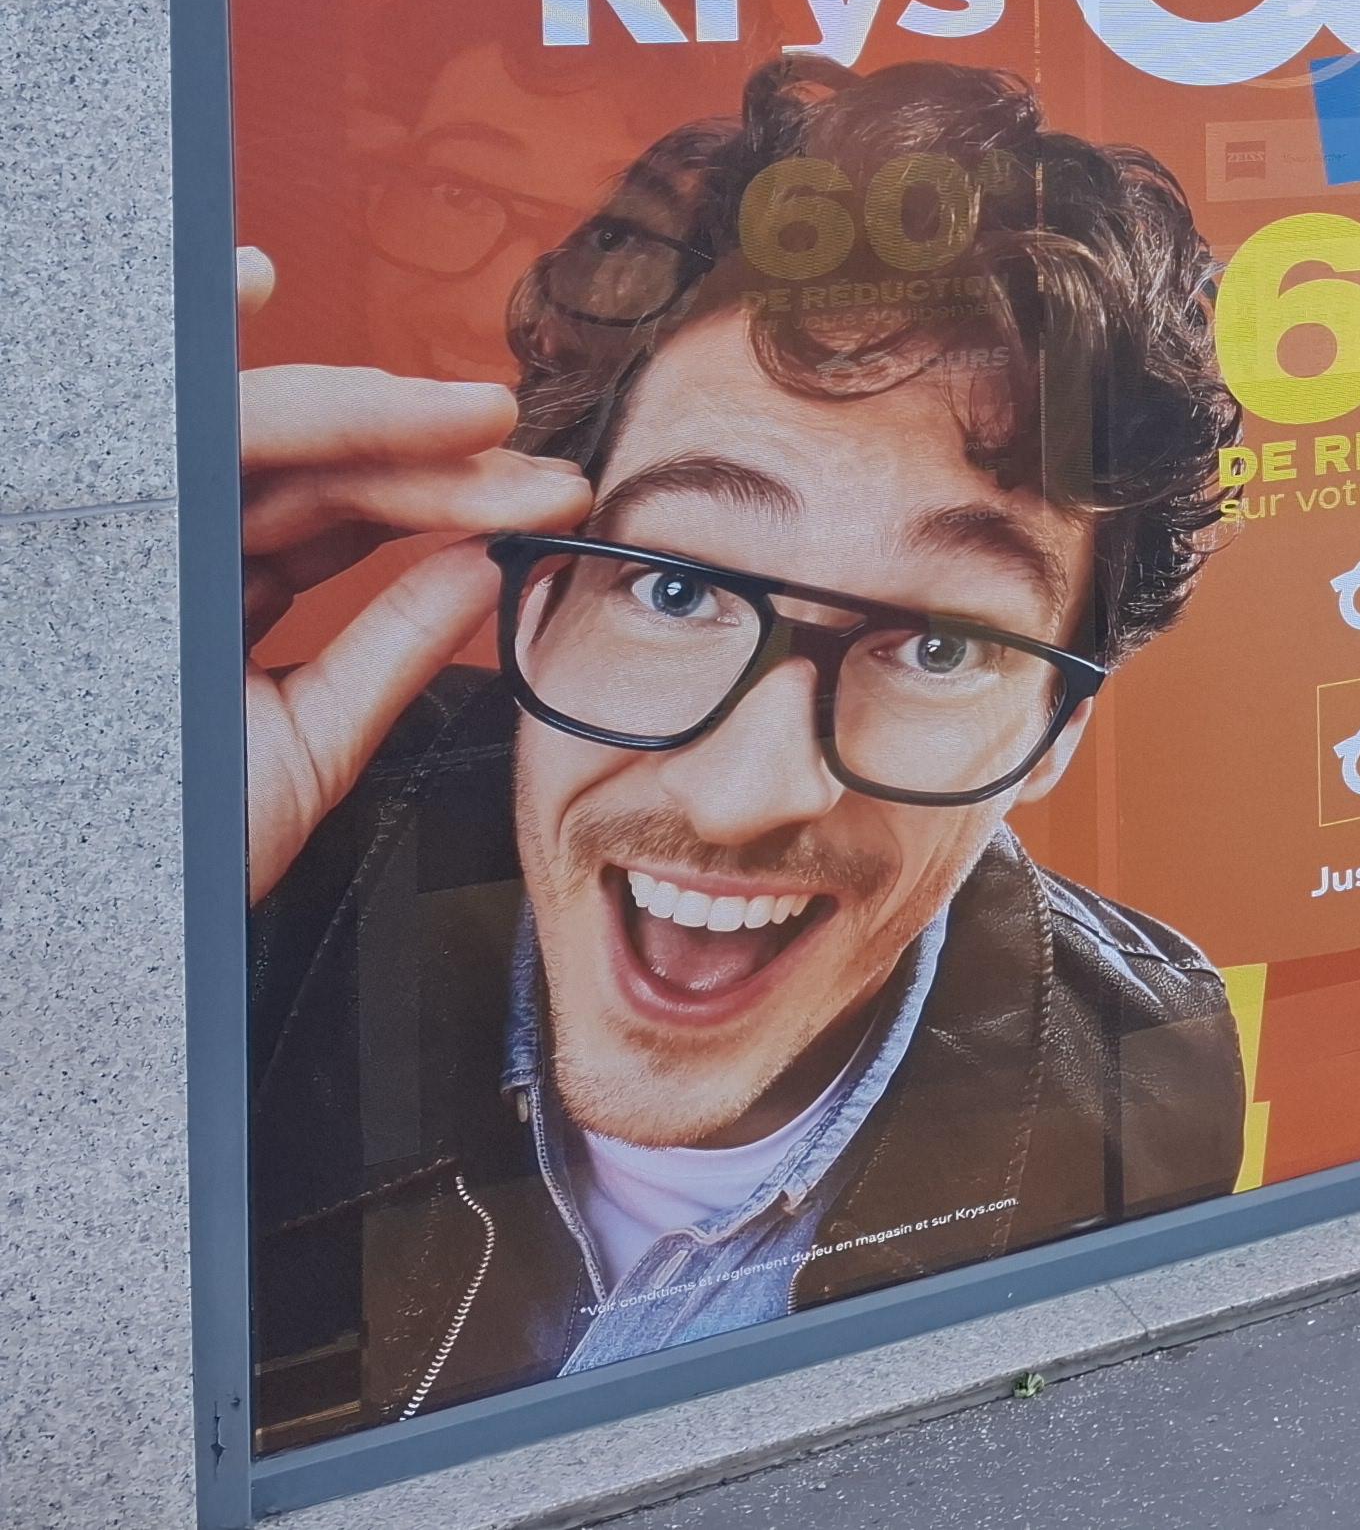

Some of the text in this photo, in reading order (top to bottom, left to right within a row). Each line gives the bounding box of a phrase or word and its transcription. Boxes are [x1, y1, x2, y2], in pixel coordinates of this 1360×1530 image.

[1219, 440, 1297, 488] DE
[1219, 492, 1285, 523] sur
[620, 1278, 696, 1308] conditions
[699, 1273, 713, 1288] et
[716, 1257, 788, 1283] règlement
[808, 1244, 832, 1263] jeu
[836, 1239, 852, 1252] en
[855, 1223, 912, 1250] magasin
[915, 1217, 929, 1230] et
[931, 1213, 953, 1229] sur
[955, 1197, 1019, 1223] Krys.com.
